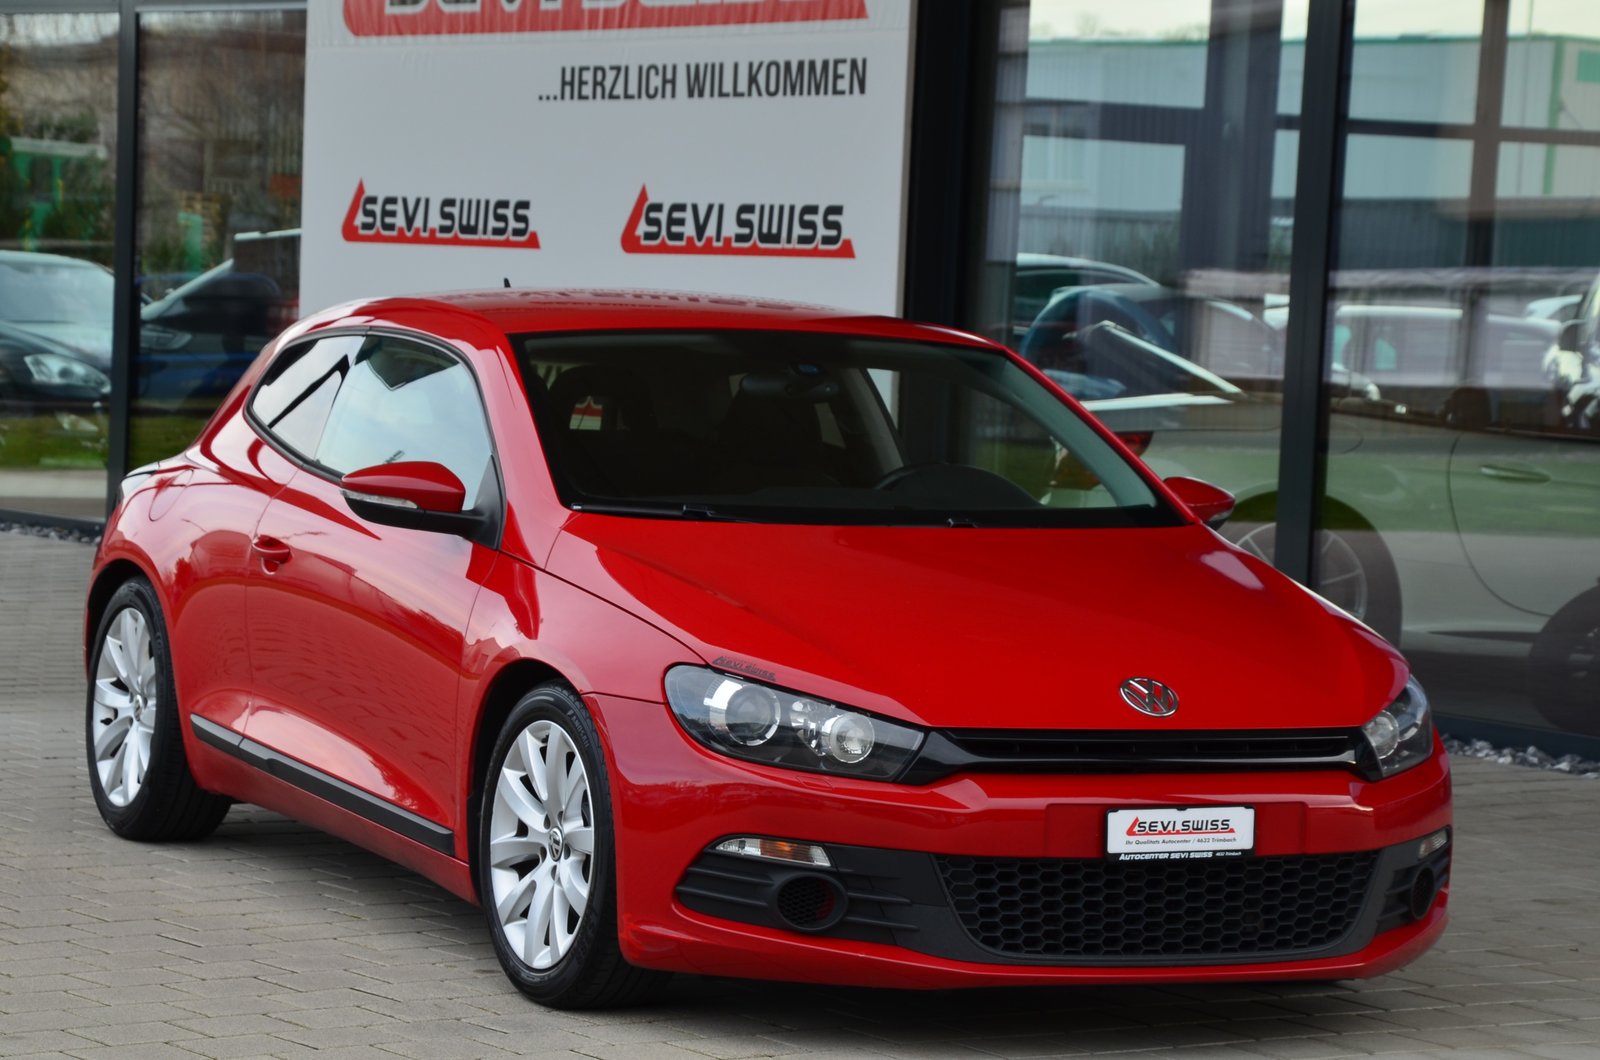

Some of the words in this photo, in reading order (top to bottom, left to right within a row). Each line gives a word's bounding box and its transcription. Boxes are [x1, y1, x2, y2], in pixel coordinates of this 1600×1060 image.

[686, 57, 867, 99] WILLKOMMEN
[360, 195, 430, 233] SEVI
[438, 197, 531, 237] SWISS
[643, 202, 725, 243] SEVI
[733, 203, 844, 246] SWISS
[1136, 820, 1177, 833] SEVI
[1181, 818, 1231, 831] SWISS
[1189, 851, 1213, 859] SWISS
